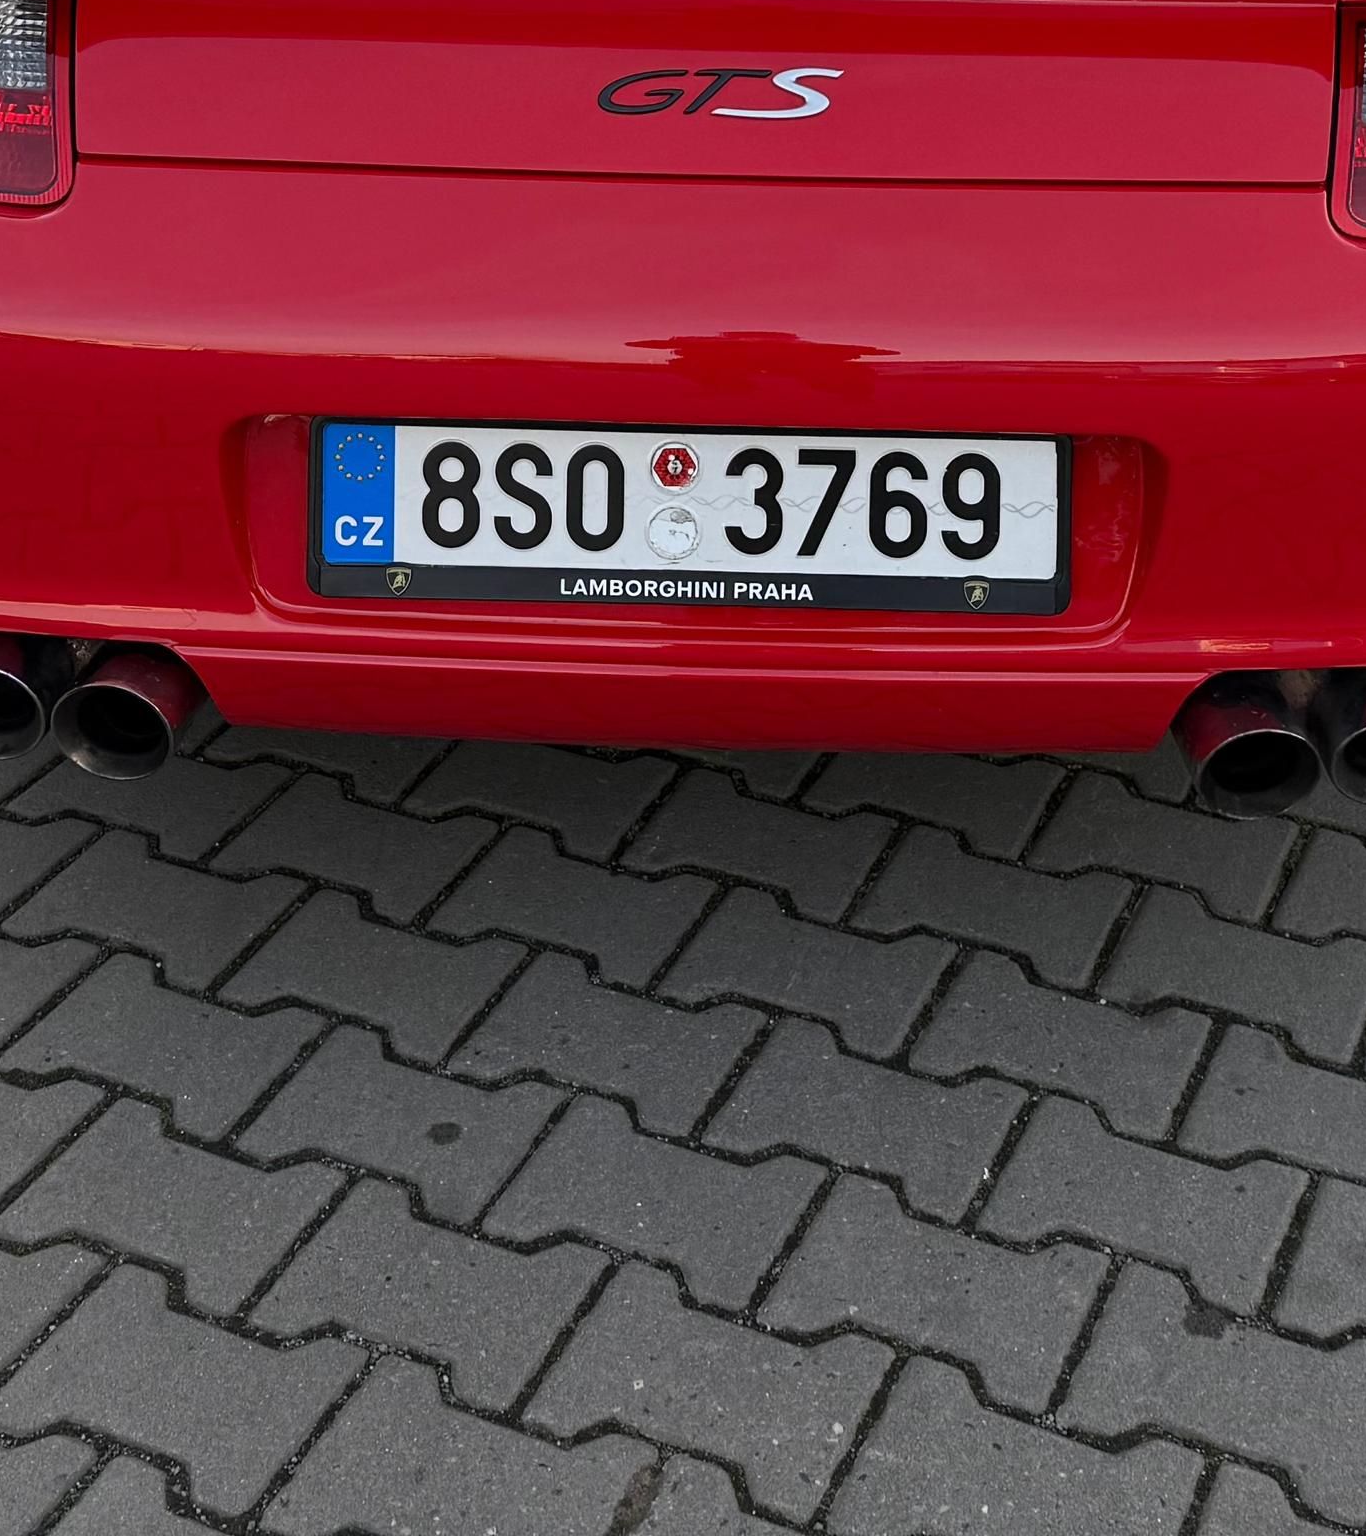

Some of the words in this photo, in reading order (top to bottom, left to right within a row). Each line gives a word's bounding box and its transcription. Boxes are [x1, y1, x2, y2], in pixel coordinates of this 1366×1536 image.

[597, 67, 845, 119] GTS
[725, 448, 1003, 560] 3769
[334, 515, 384, 549] CZ
[560, 578, 726, 599] LAMBORGHINI
[734, 582, 814, 602] PRAHA
